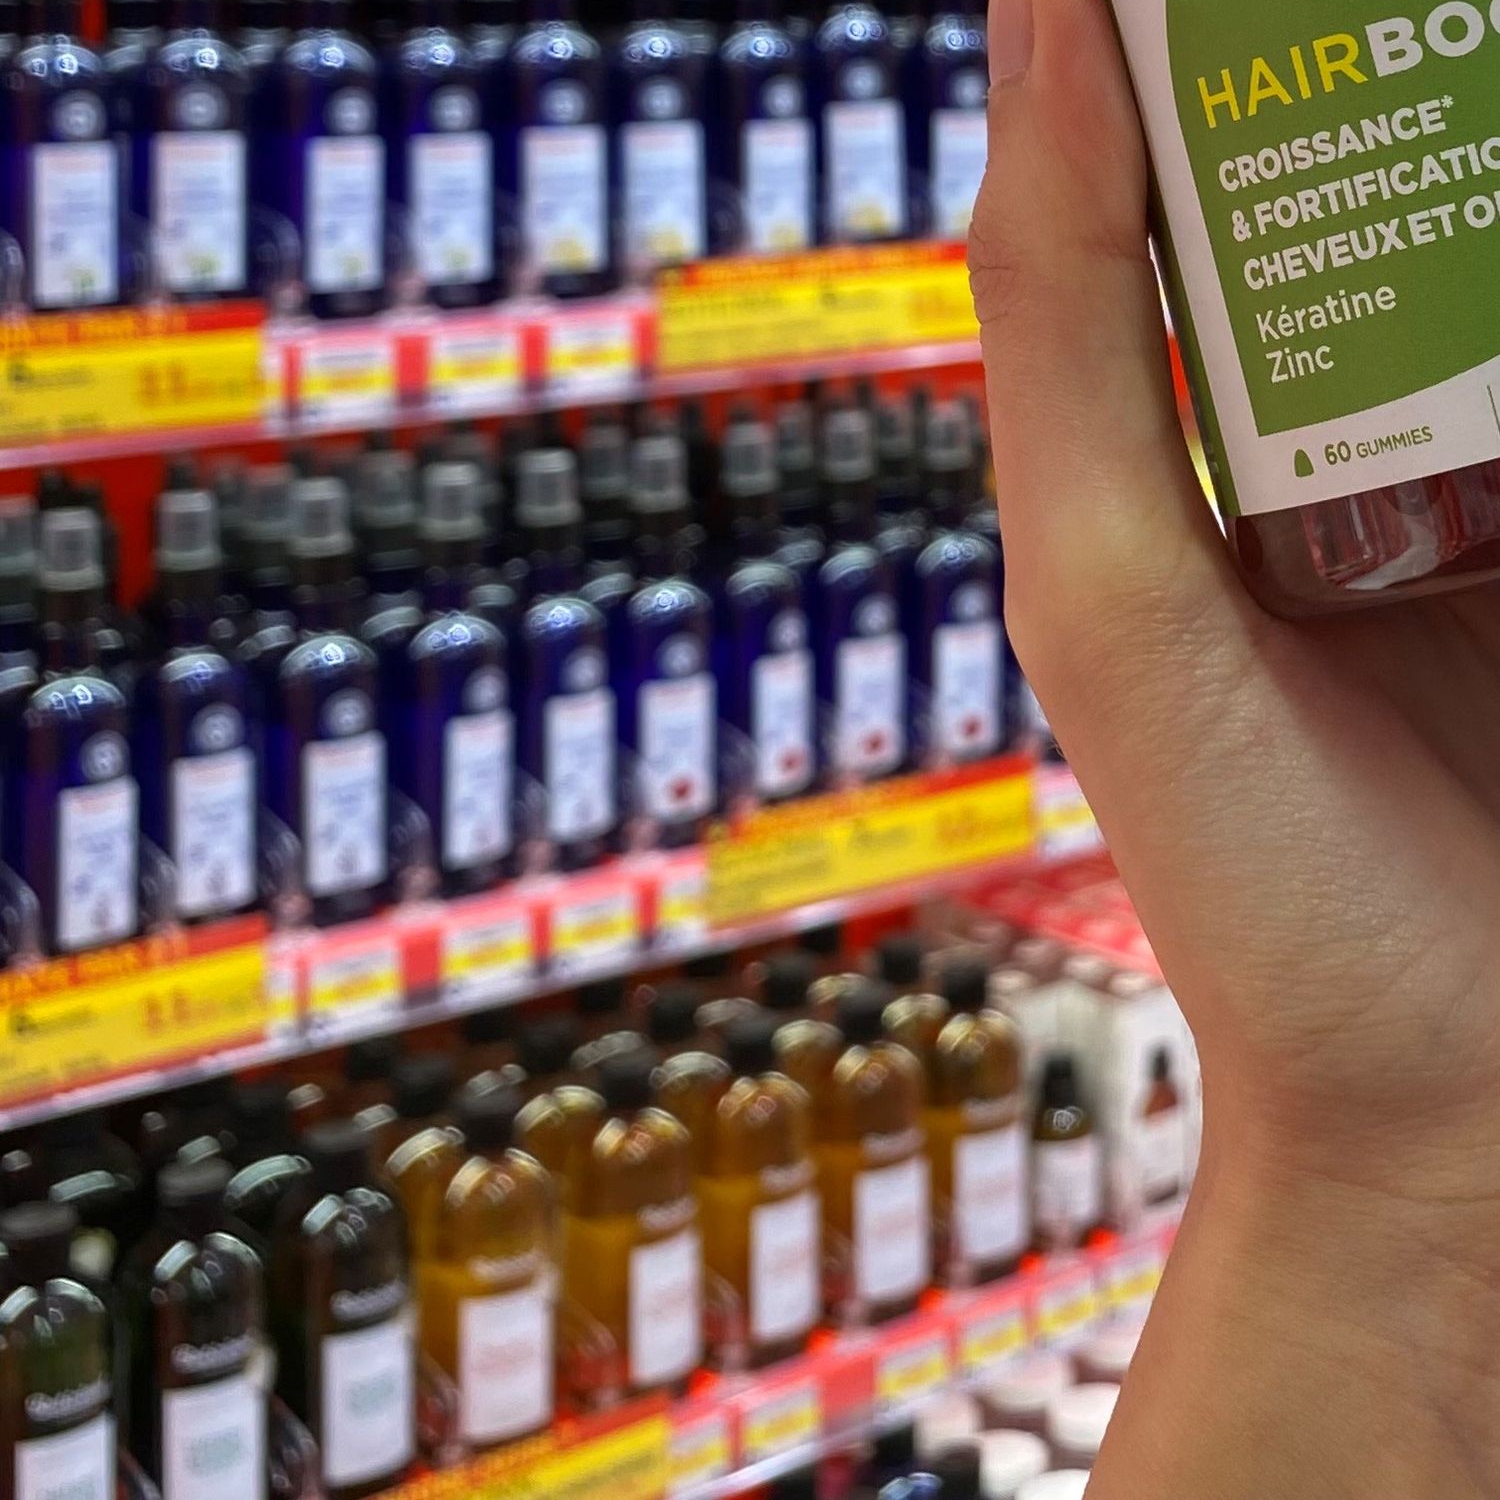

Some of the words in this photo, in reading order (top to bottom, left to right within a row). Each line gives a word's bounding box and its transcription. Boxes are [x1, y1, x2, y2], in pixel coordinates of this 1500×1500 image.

[1230, 209, 1253, 243] &
[1243, 218, 1408, 291] CHEVEUX
[1406, 203, 1457, 247] ET
[1255, 284, 1397, 343] Kératine
[1265, 343, 1335, 384] Zinc
[1323, 439, 1352, 466] 60
[1355, 425, 1434, 459] GUMMIES
